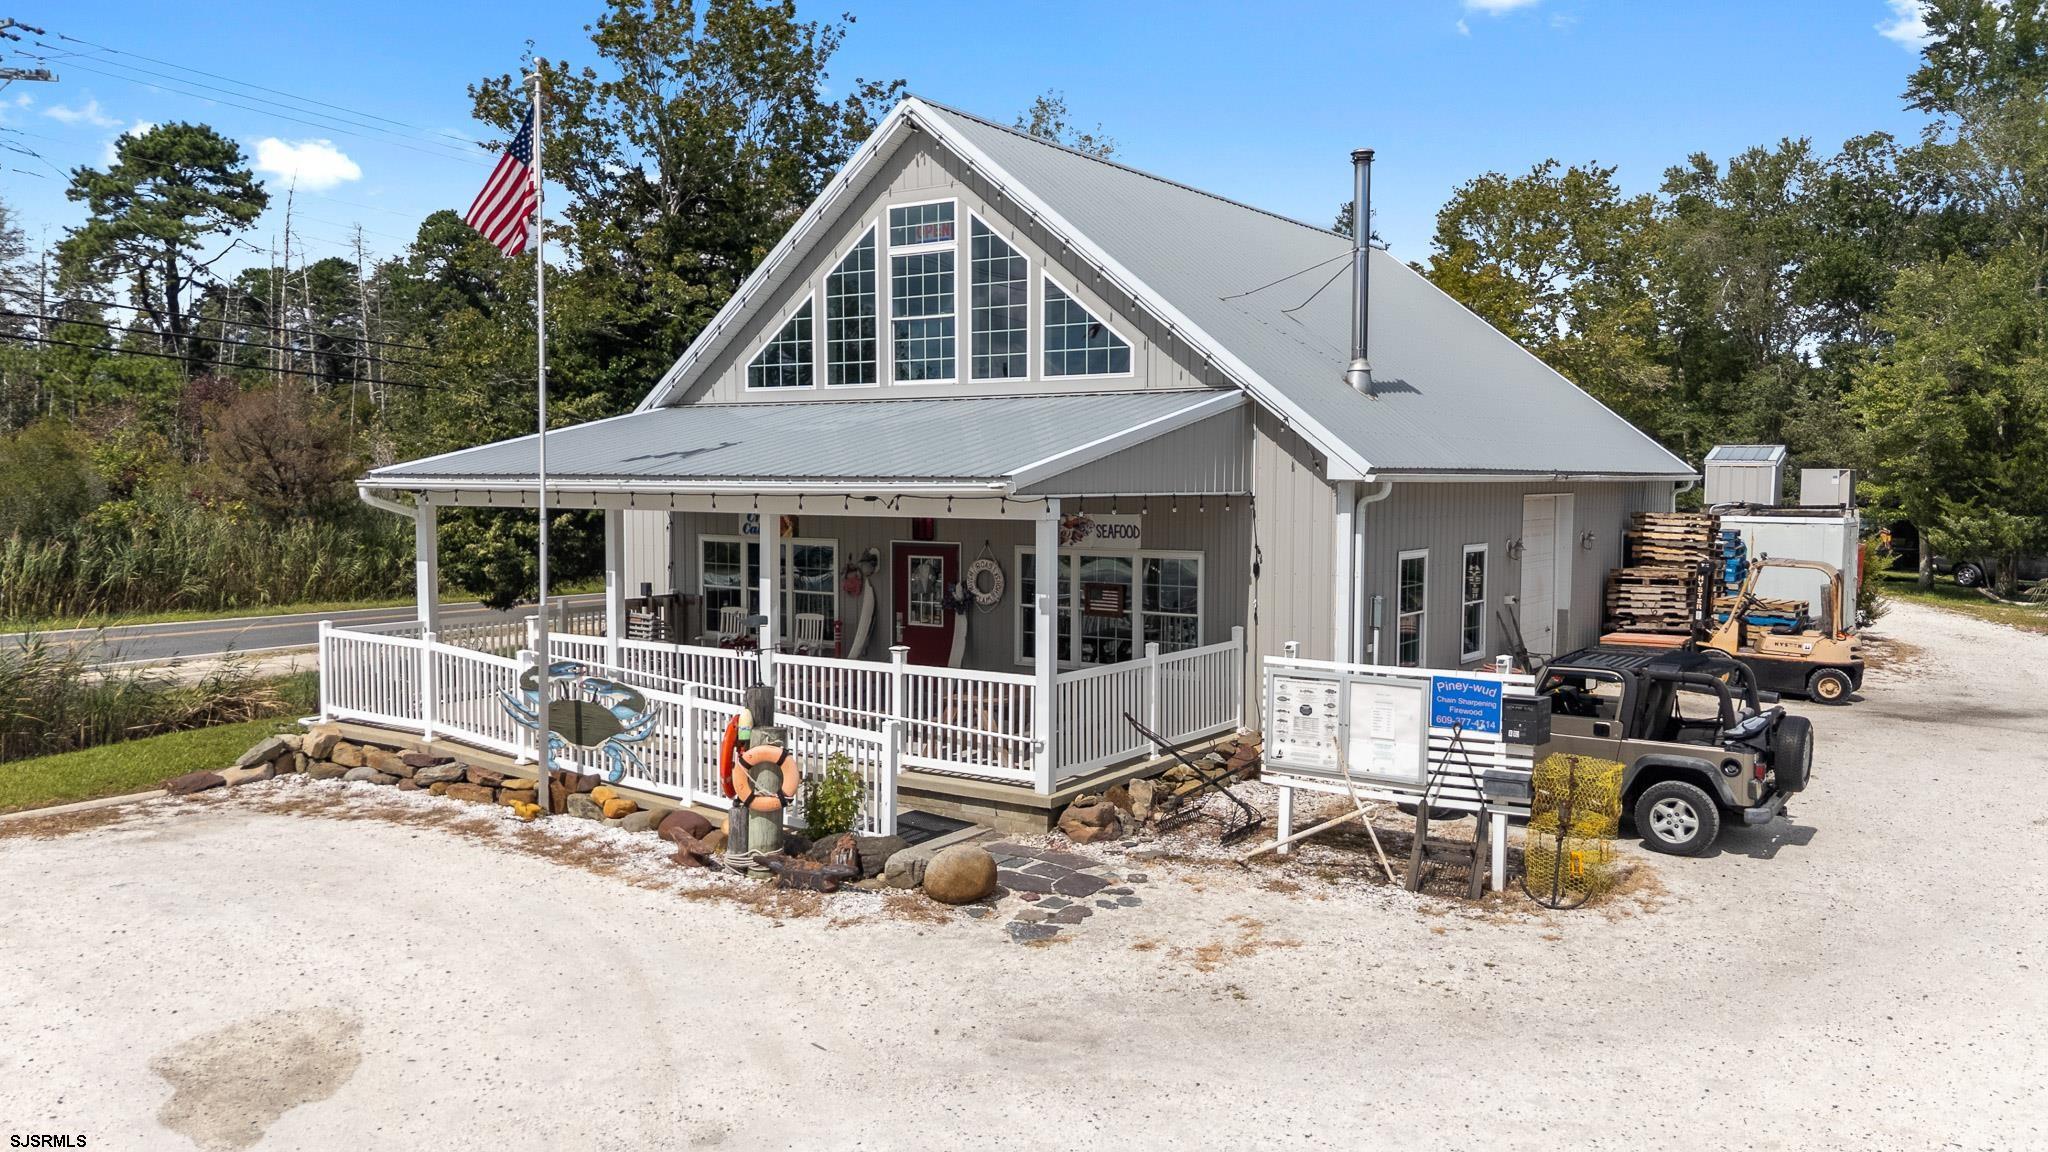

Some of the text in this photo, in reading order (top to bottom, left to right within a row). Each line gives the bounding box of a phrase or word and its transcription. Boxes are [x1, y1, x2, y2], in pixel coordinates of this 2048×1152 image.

[917, 223, 951, 239] OPEN
[1096, 524, 1141, 539] SEAFOOD
[976, 561, 993, 569] ROAD
[1696, 574, 1704, 610] HYSTER
[1436, 681, 1497, 698] Piney-wud
[1457, 697, 1497, 709] Sharpening
[1449, 706, 1483, 716] Firewood
